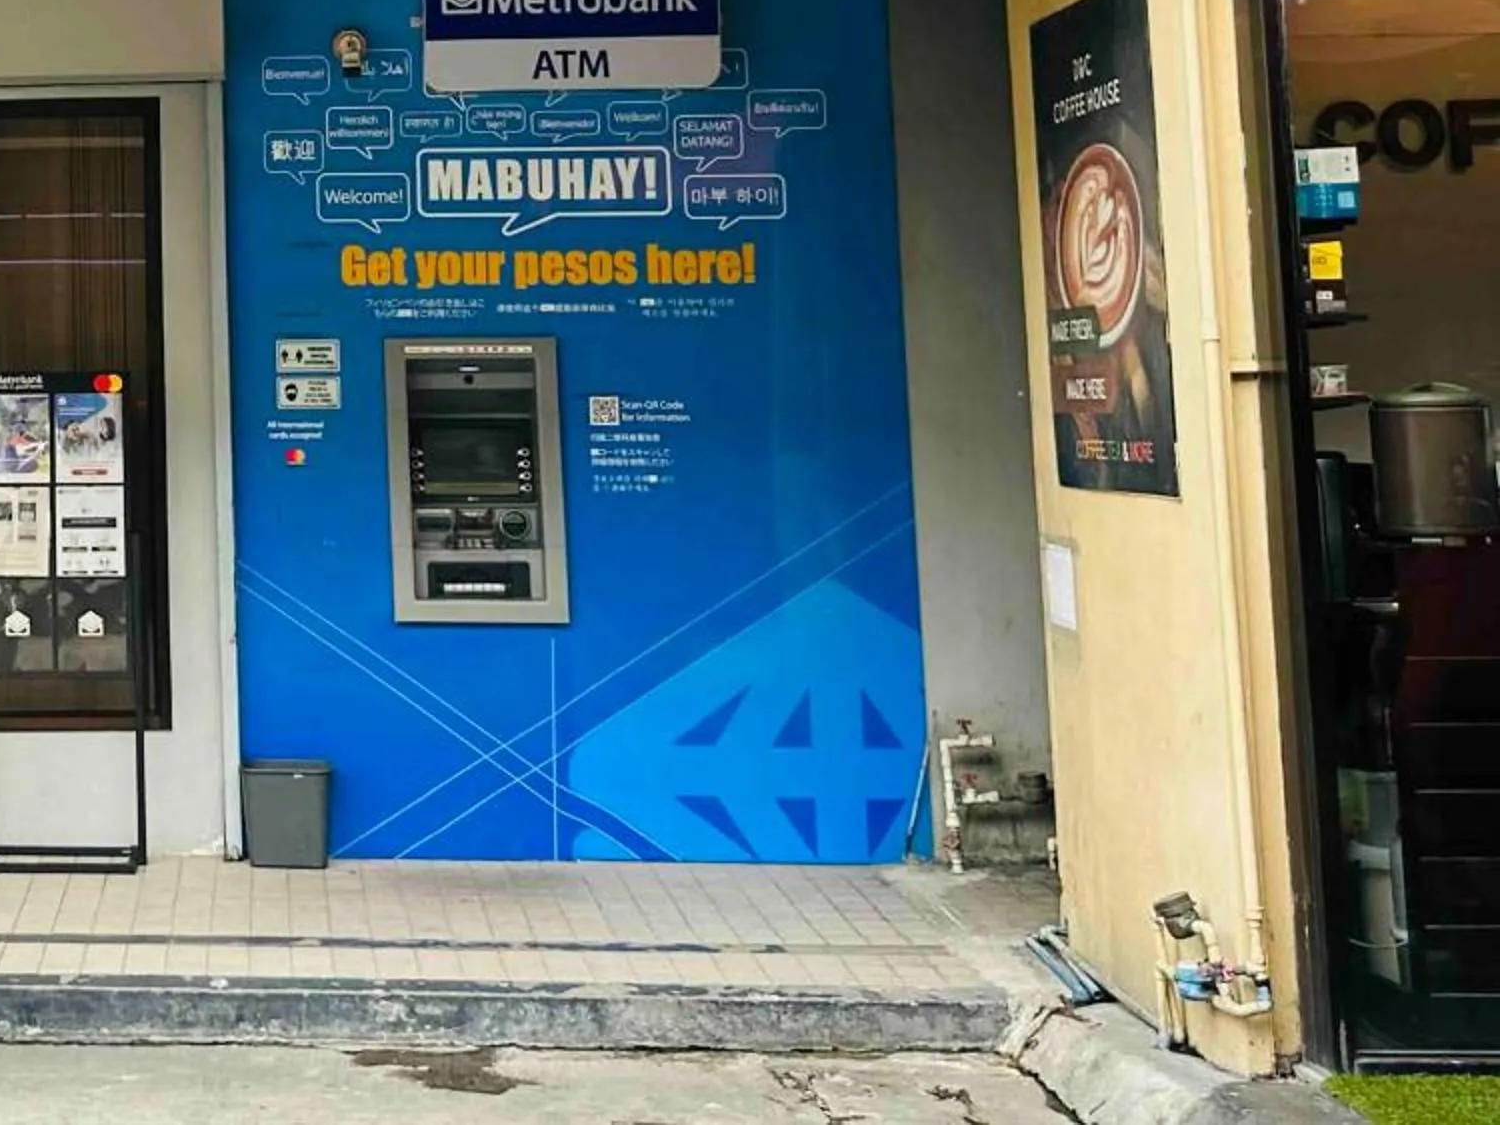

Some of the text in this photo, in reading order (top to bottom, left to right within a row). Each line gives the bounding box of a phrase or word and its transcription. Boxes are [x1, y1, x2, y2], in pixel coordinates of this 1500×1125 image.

[532, 50, 611, 80] ATM
[1054, 78, 1121, 124] COFFEE HOUSE
[678, 121, 733, 132] SELAMAT
[681, 136, 734, 148] DATANG!
[427, 157, 658, 203] MABUHAY!
[324, 188, 403, 205] Welcome!
[340, 241, 757, 291] Get your pesos here!
